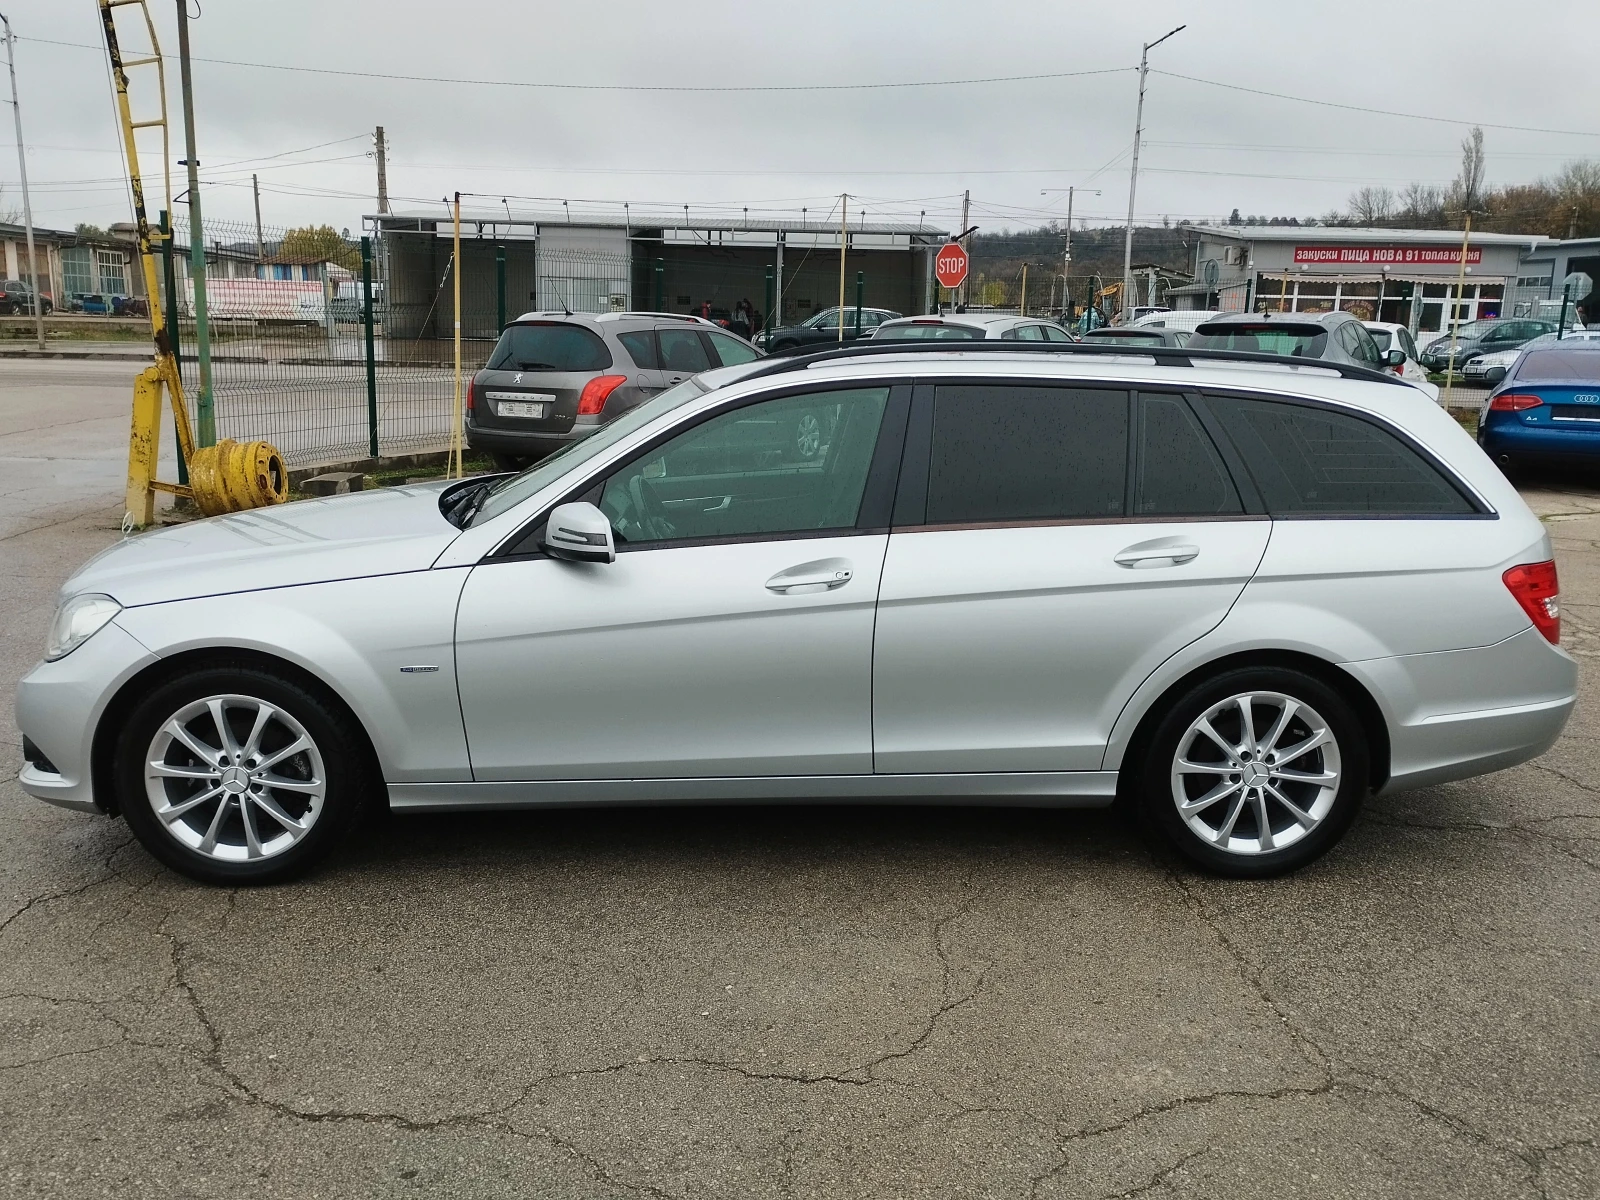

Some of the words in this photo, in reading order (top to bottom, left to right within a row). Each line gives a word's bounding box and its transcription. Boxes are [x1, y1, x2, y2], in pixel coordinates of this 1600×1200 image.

[1297, 250, 1338, 261] закуски
[1341, 249, 1370, 262] ПИЦА
[1405, 249, 1419, 261] 91
[1450, 251, 1480, 261] куня
[938, 257, 965, 274] STOP
